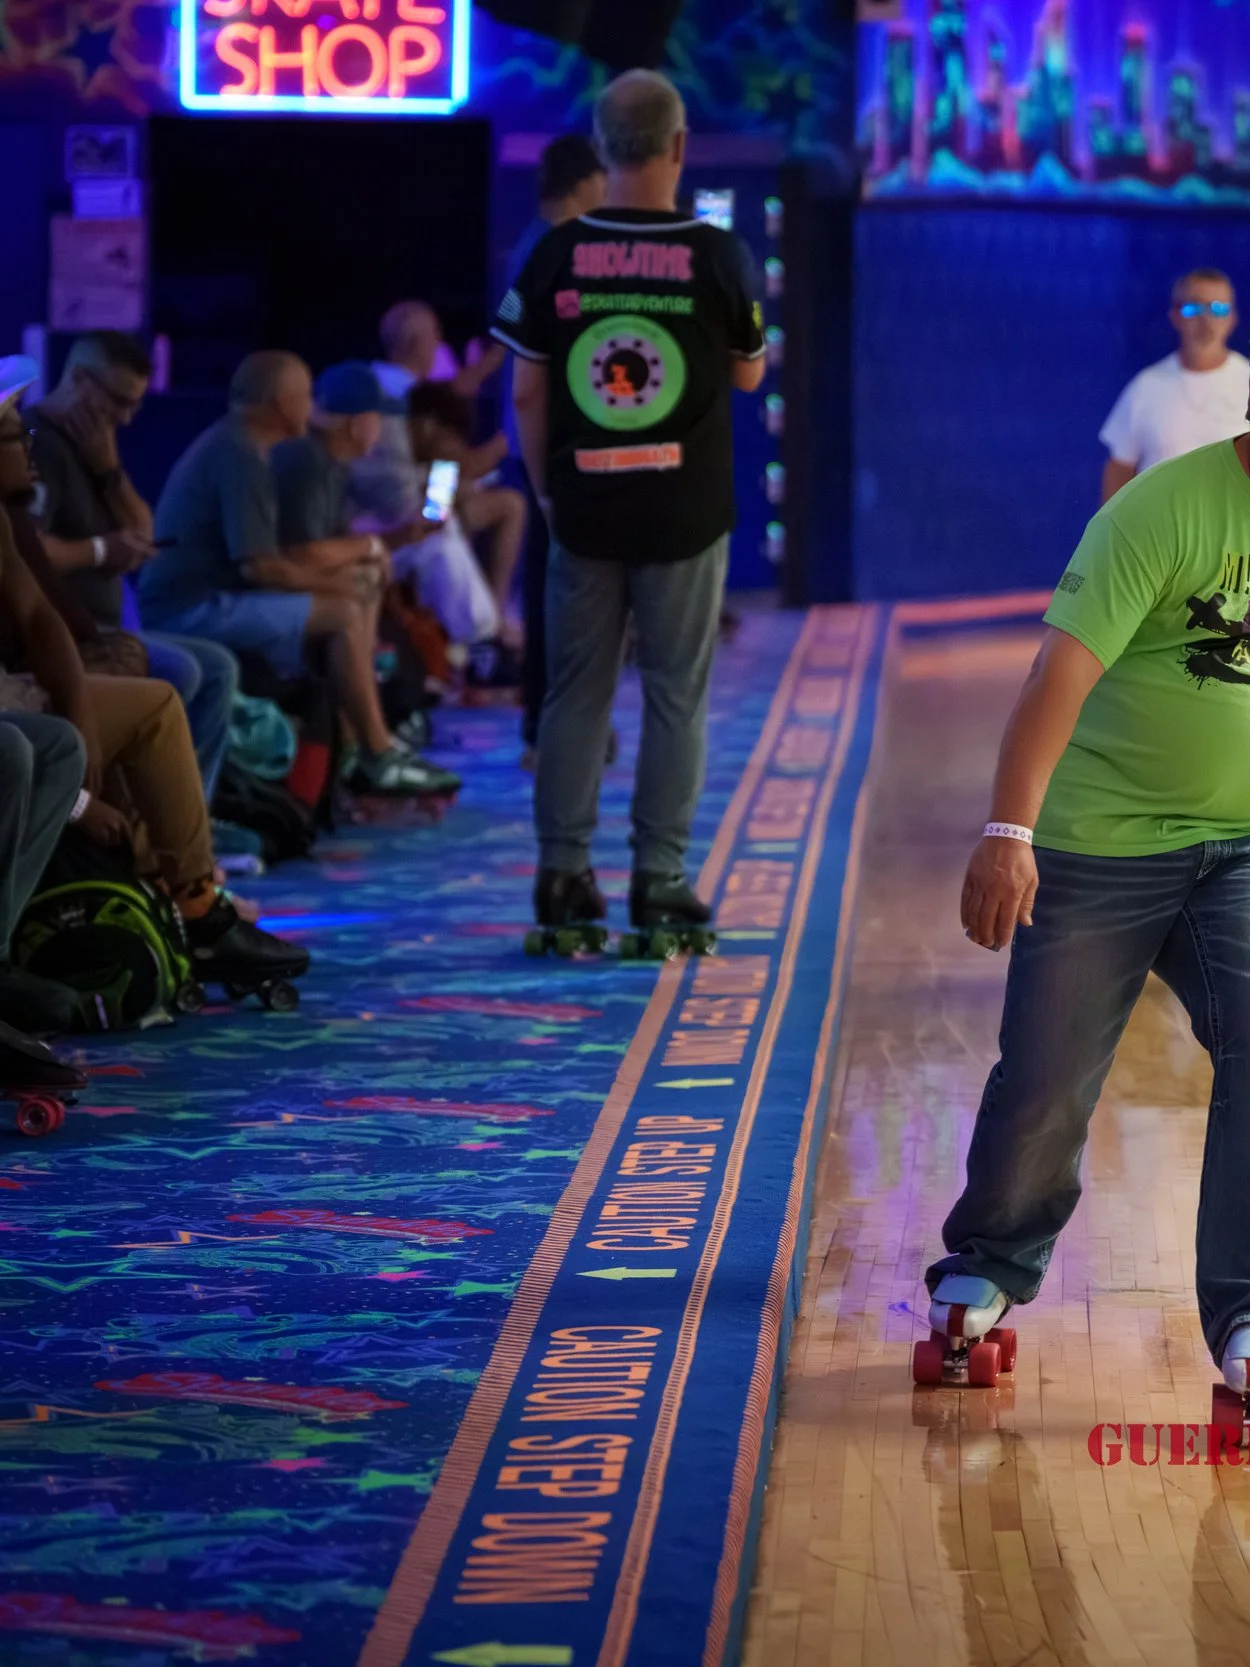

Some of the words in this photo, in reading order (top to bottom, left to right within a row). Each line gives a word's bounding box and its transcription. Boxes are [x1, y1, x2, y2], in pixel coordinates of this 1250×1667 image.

[215, 22, 442, 101] SHOP
[617, 1141, 717, 1176] STEP
[634, 1115, 725, 1136] UP
[586, 1181, 707, 1251] CAUTION
[520, 1325, 663, 1422] CAUTION
[495, 1433, 634, 1498] STEP
[453, 1511, 613, 1604] DOWN
